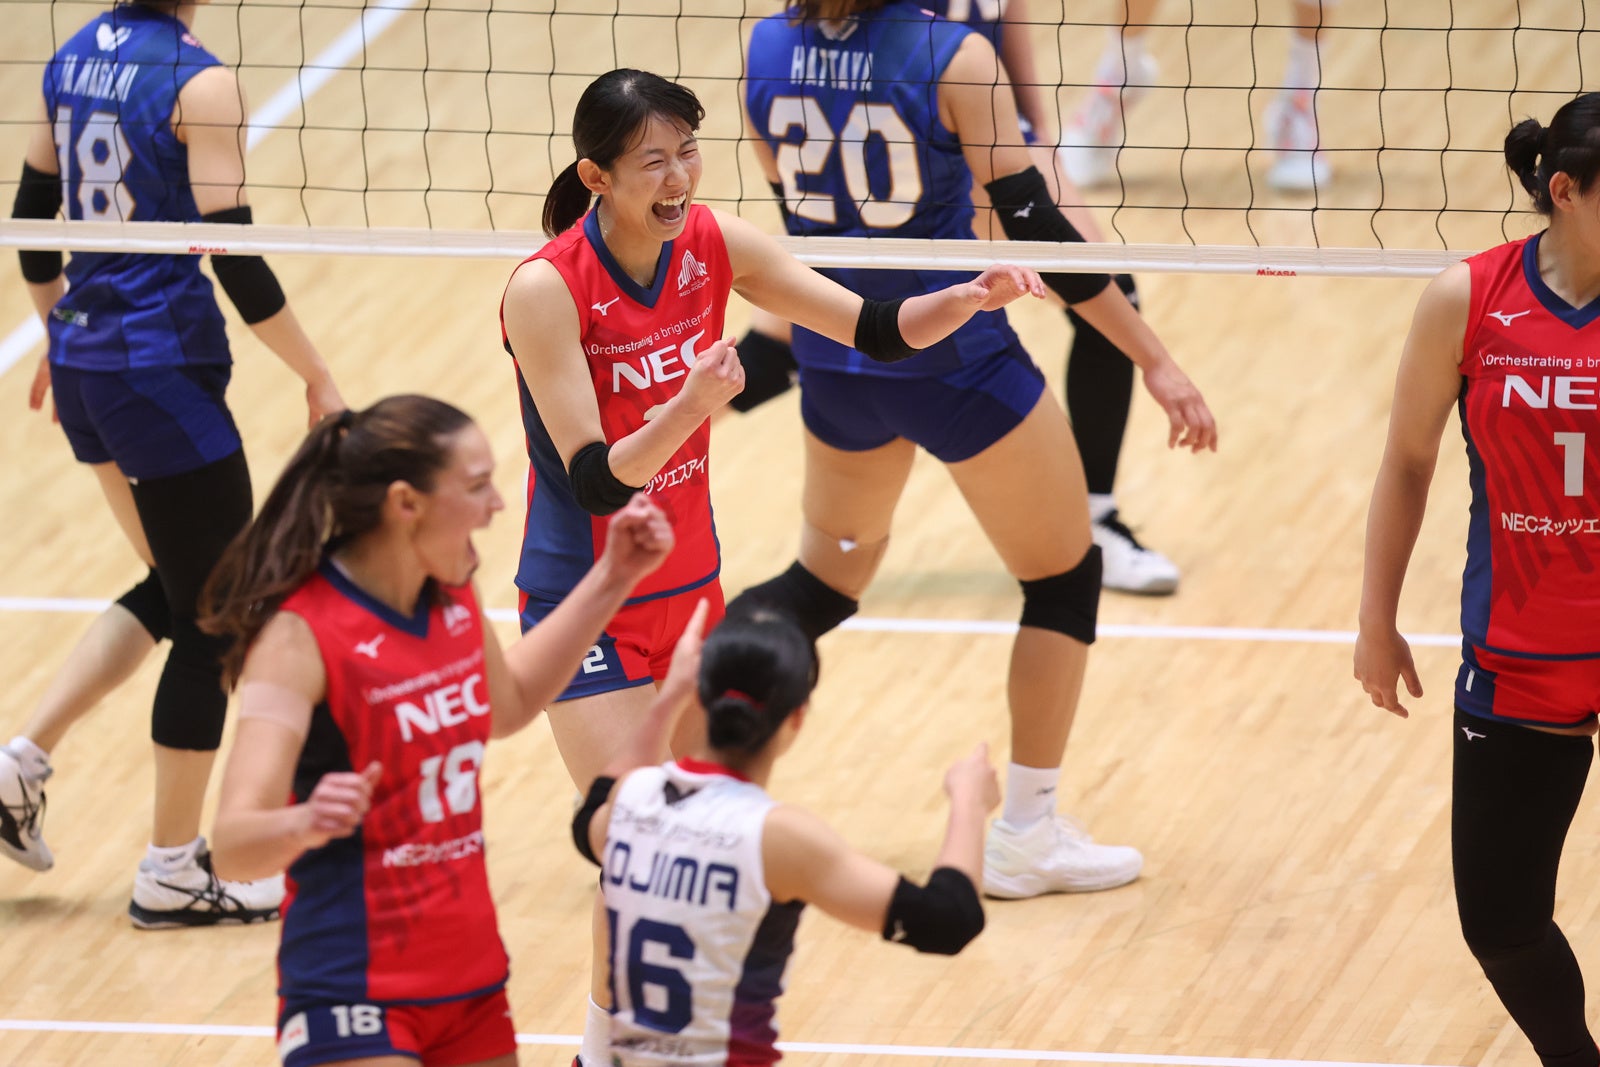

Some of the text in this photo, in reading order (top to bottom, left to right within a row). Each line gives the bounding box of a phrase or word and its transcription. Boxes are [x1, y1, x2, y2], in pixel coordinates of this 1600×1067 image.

[54, 106, 136, 221] 18
[769, 96, 923, 228] 20
[654, 332, 660, 340] a
[660, 315, 702, 338] brighter
[612, 328, 705, 393] NEC
[1502, 374, 1600, 410] NE
[1575, 358, 1583, 368] a
[1553, 432, 1585, 496] 1
[582, 644, 609, 674] 2
[394, 673, 491, 743] NEC
[418, 739, 486, 824] 18
[605, 840, 739, 910] OJIMA
[331, 1004, 382, 1038] 18
